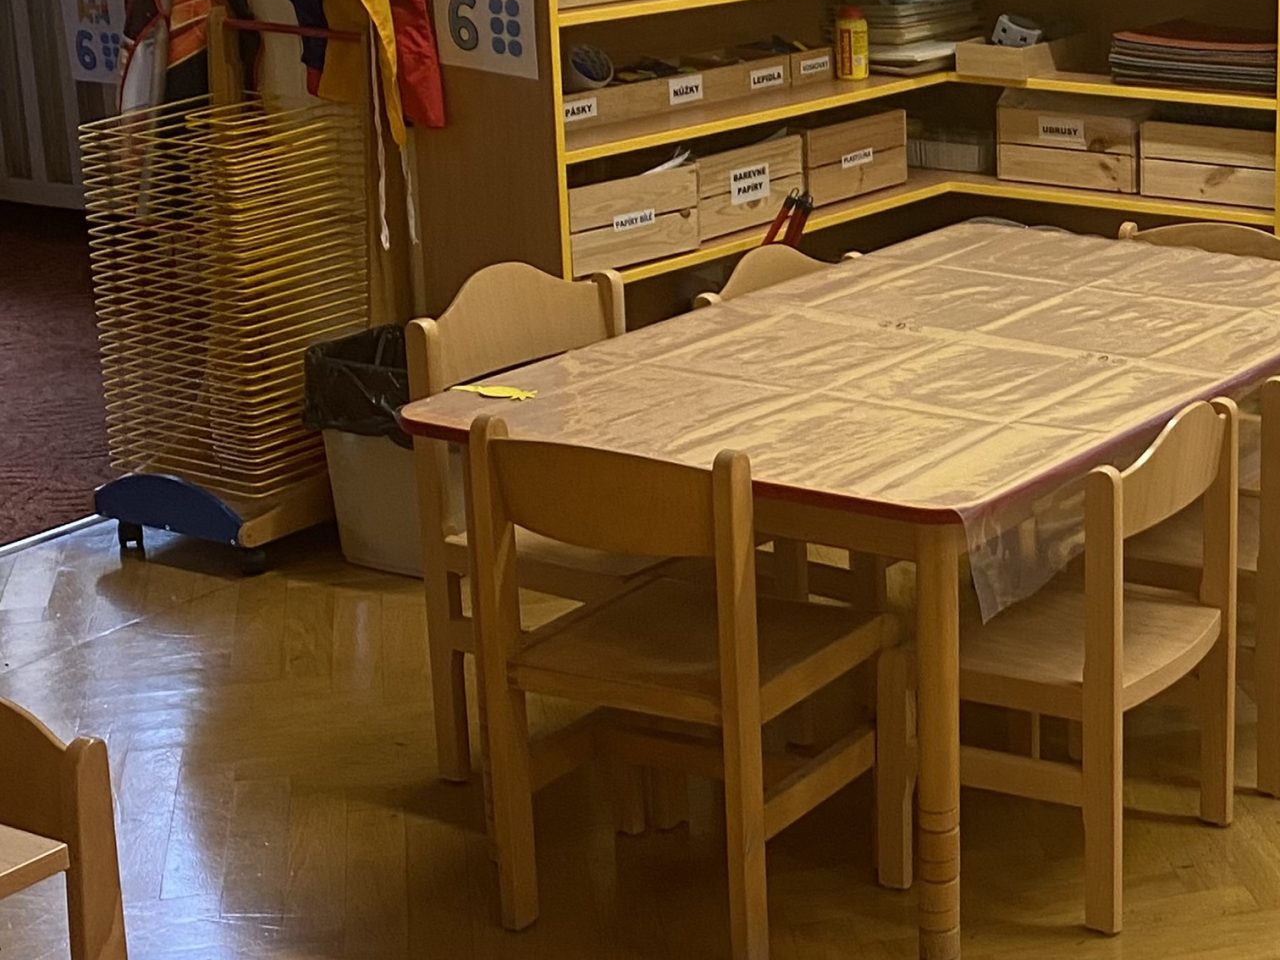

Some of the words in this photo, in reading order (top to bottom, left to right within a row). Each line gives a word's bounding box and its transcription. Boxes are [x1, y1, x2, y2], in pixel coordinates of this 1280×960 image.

[75, 30, 97, 71] 6
[753, 72, 782, 85] LEPIDLA
[565, 103, 593, 118] PÁSKY
[1042, 125, 1079, 136] UBRUSY
[733, 166, 766, 182] BAREVNÉ
[737, 181, 763, 195] PAPÍRY
